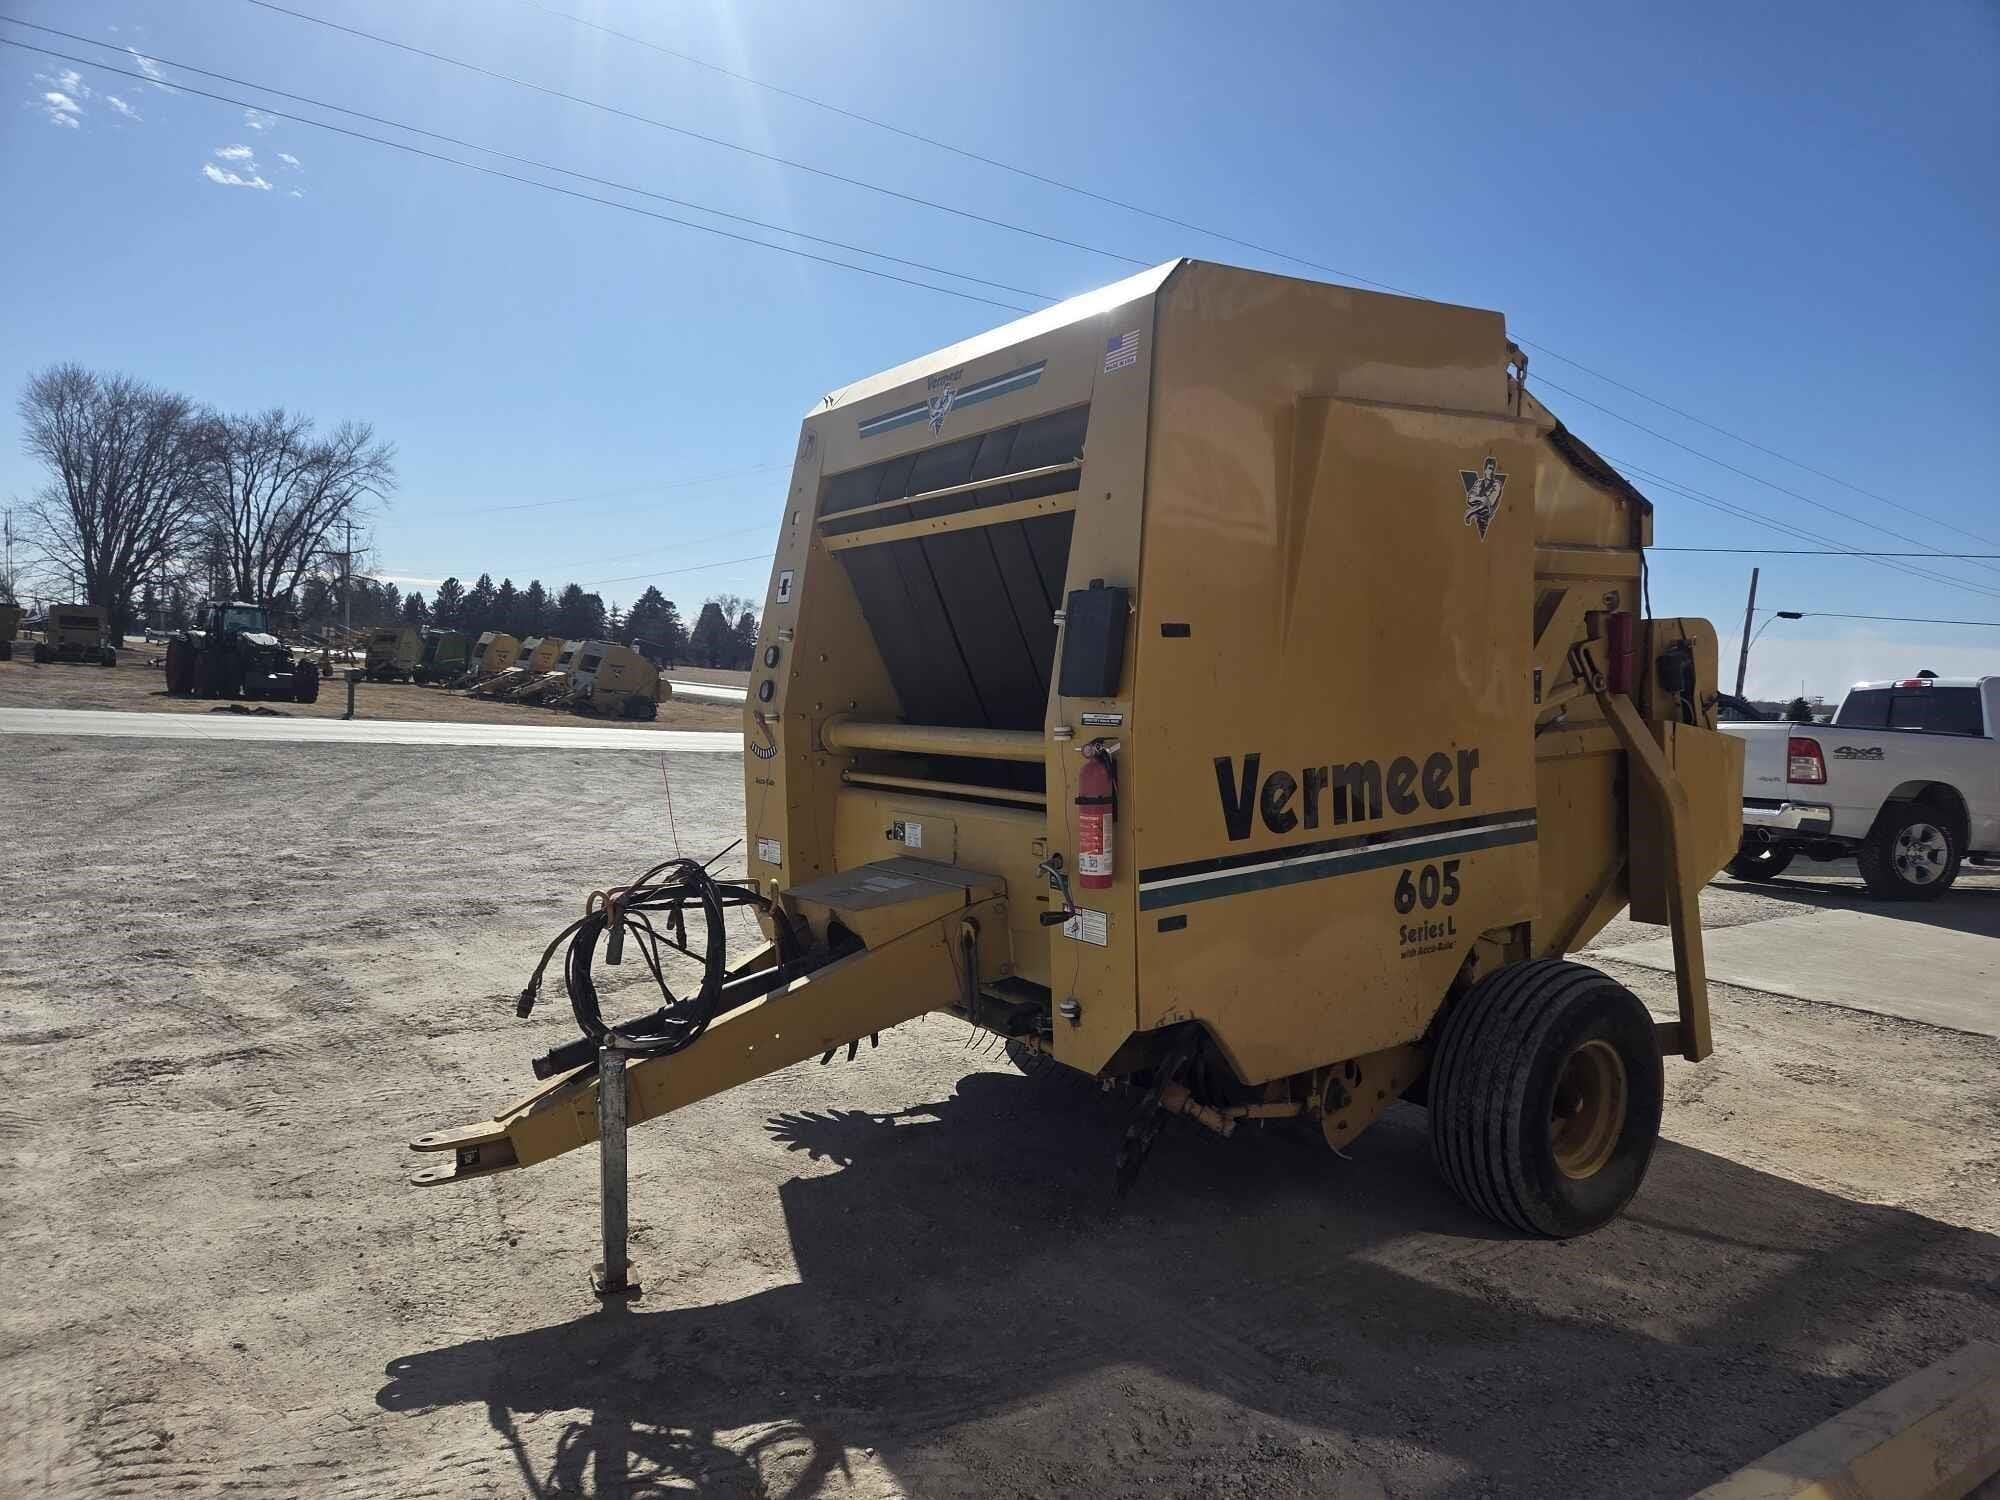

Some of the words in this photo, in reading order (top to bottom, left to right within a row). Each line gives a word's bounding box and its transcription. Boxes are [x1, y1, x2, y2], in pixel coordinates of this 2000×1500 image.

[927, 368, 964, 390] Vermeer
[1214, 749, 1479, 841] Vermeer
[1394, 860, 1460, 914] 605
[1399, 920, 1444, 946] Series
[1447, 915, 1457, 936] L
